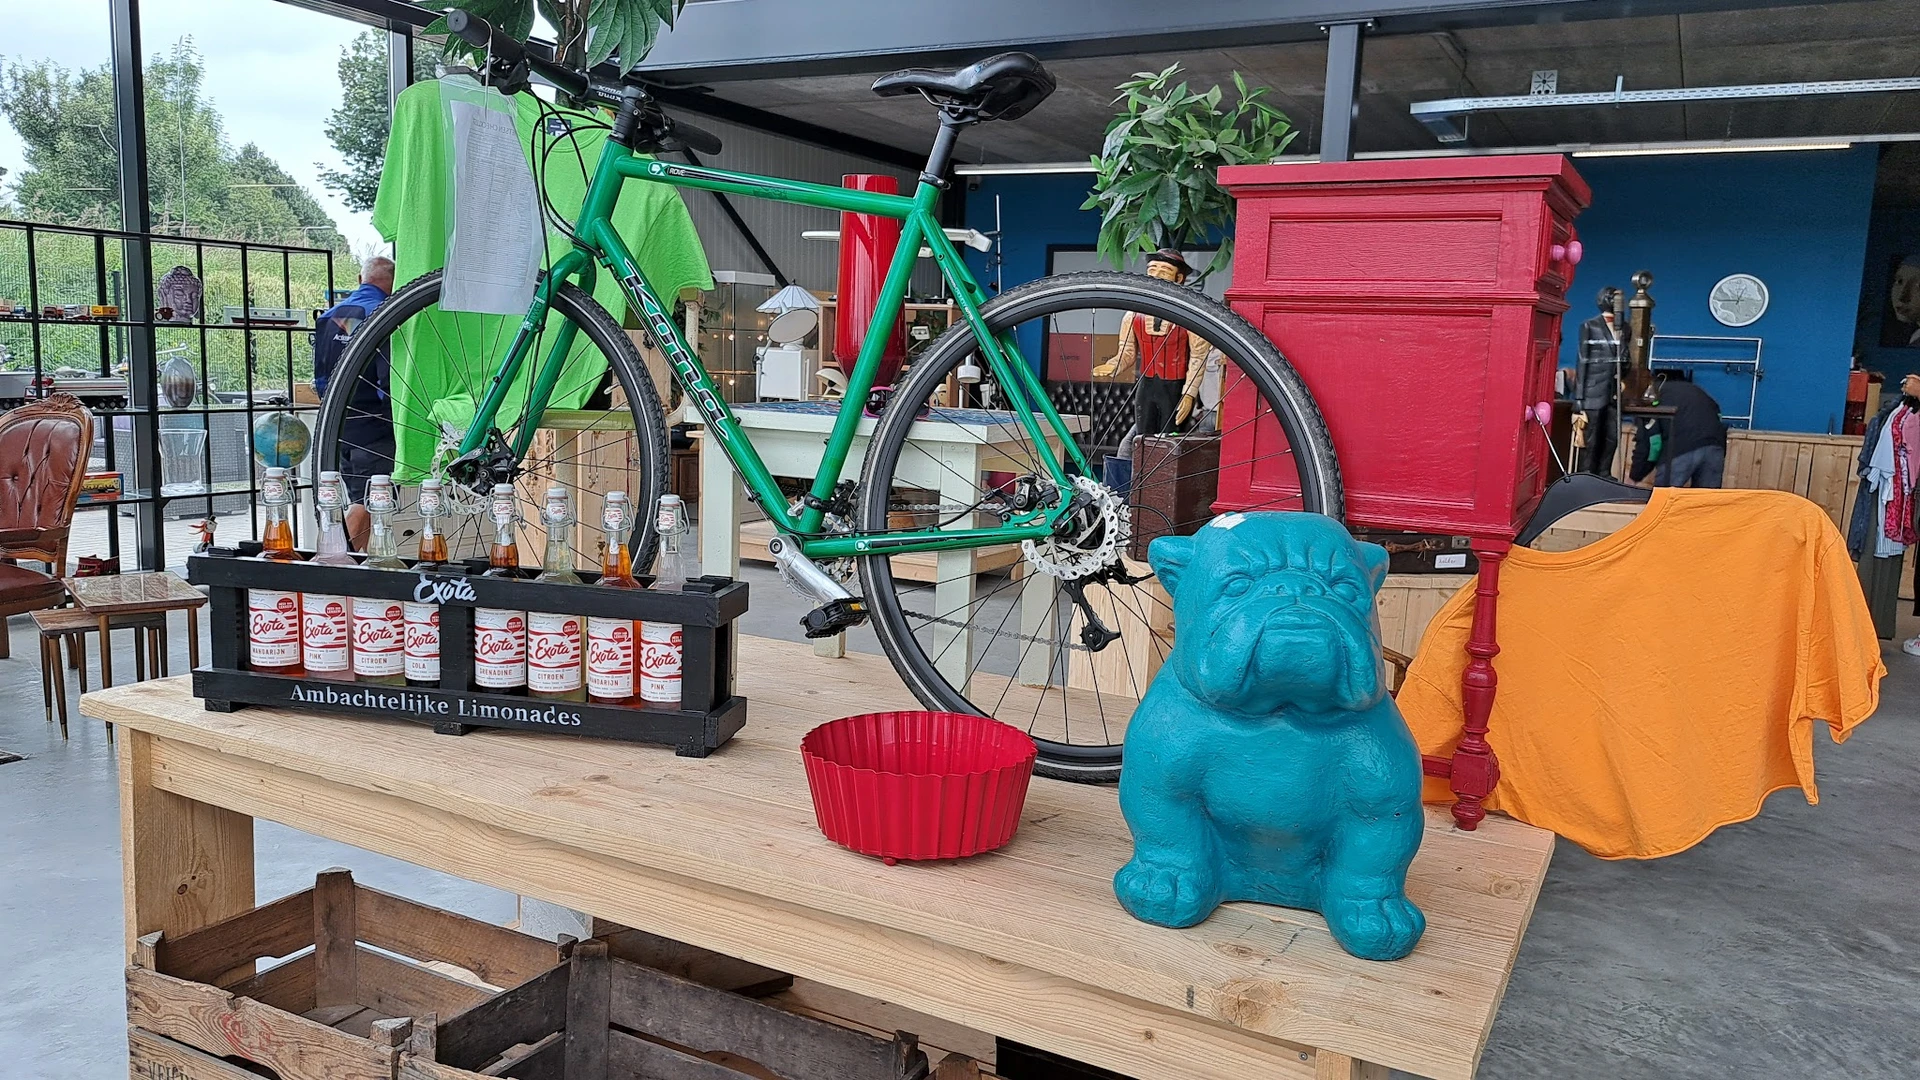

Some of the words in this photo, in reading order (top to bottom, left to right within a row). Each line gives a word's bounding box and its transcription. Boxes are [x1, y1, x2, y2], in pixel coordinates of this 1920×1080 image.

[413, 572, 478, 605] Exota
[252, 613, 285, 636] Exota
[304, 617, 334, 639] Exota
[358, 622, 393, 645] Exota
[406, 626, 438, 649] Exota
[480, 633, 515, 656] Exota
[535, 637, 570, 660] Exota
[308, 652, 322, 660] PINK
[361, 656, 388, 664] CITROEN
[589, 642, 620, 664] Exota
[644, 647, 678, 670] Exota
[411, 662, 427, 670] COLA
[479, 667, 513, 676] GRENADINE
[537, 672, 564, 680] CITROEN
[650, 683, 665, 691] PINK
[289, 684, 449, 716] Ambachtelijke
[457, 699, 582, 726] Limonades
